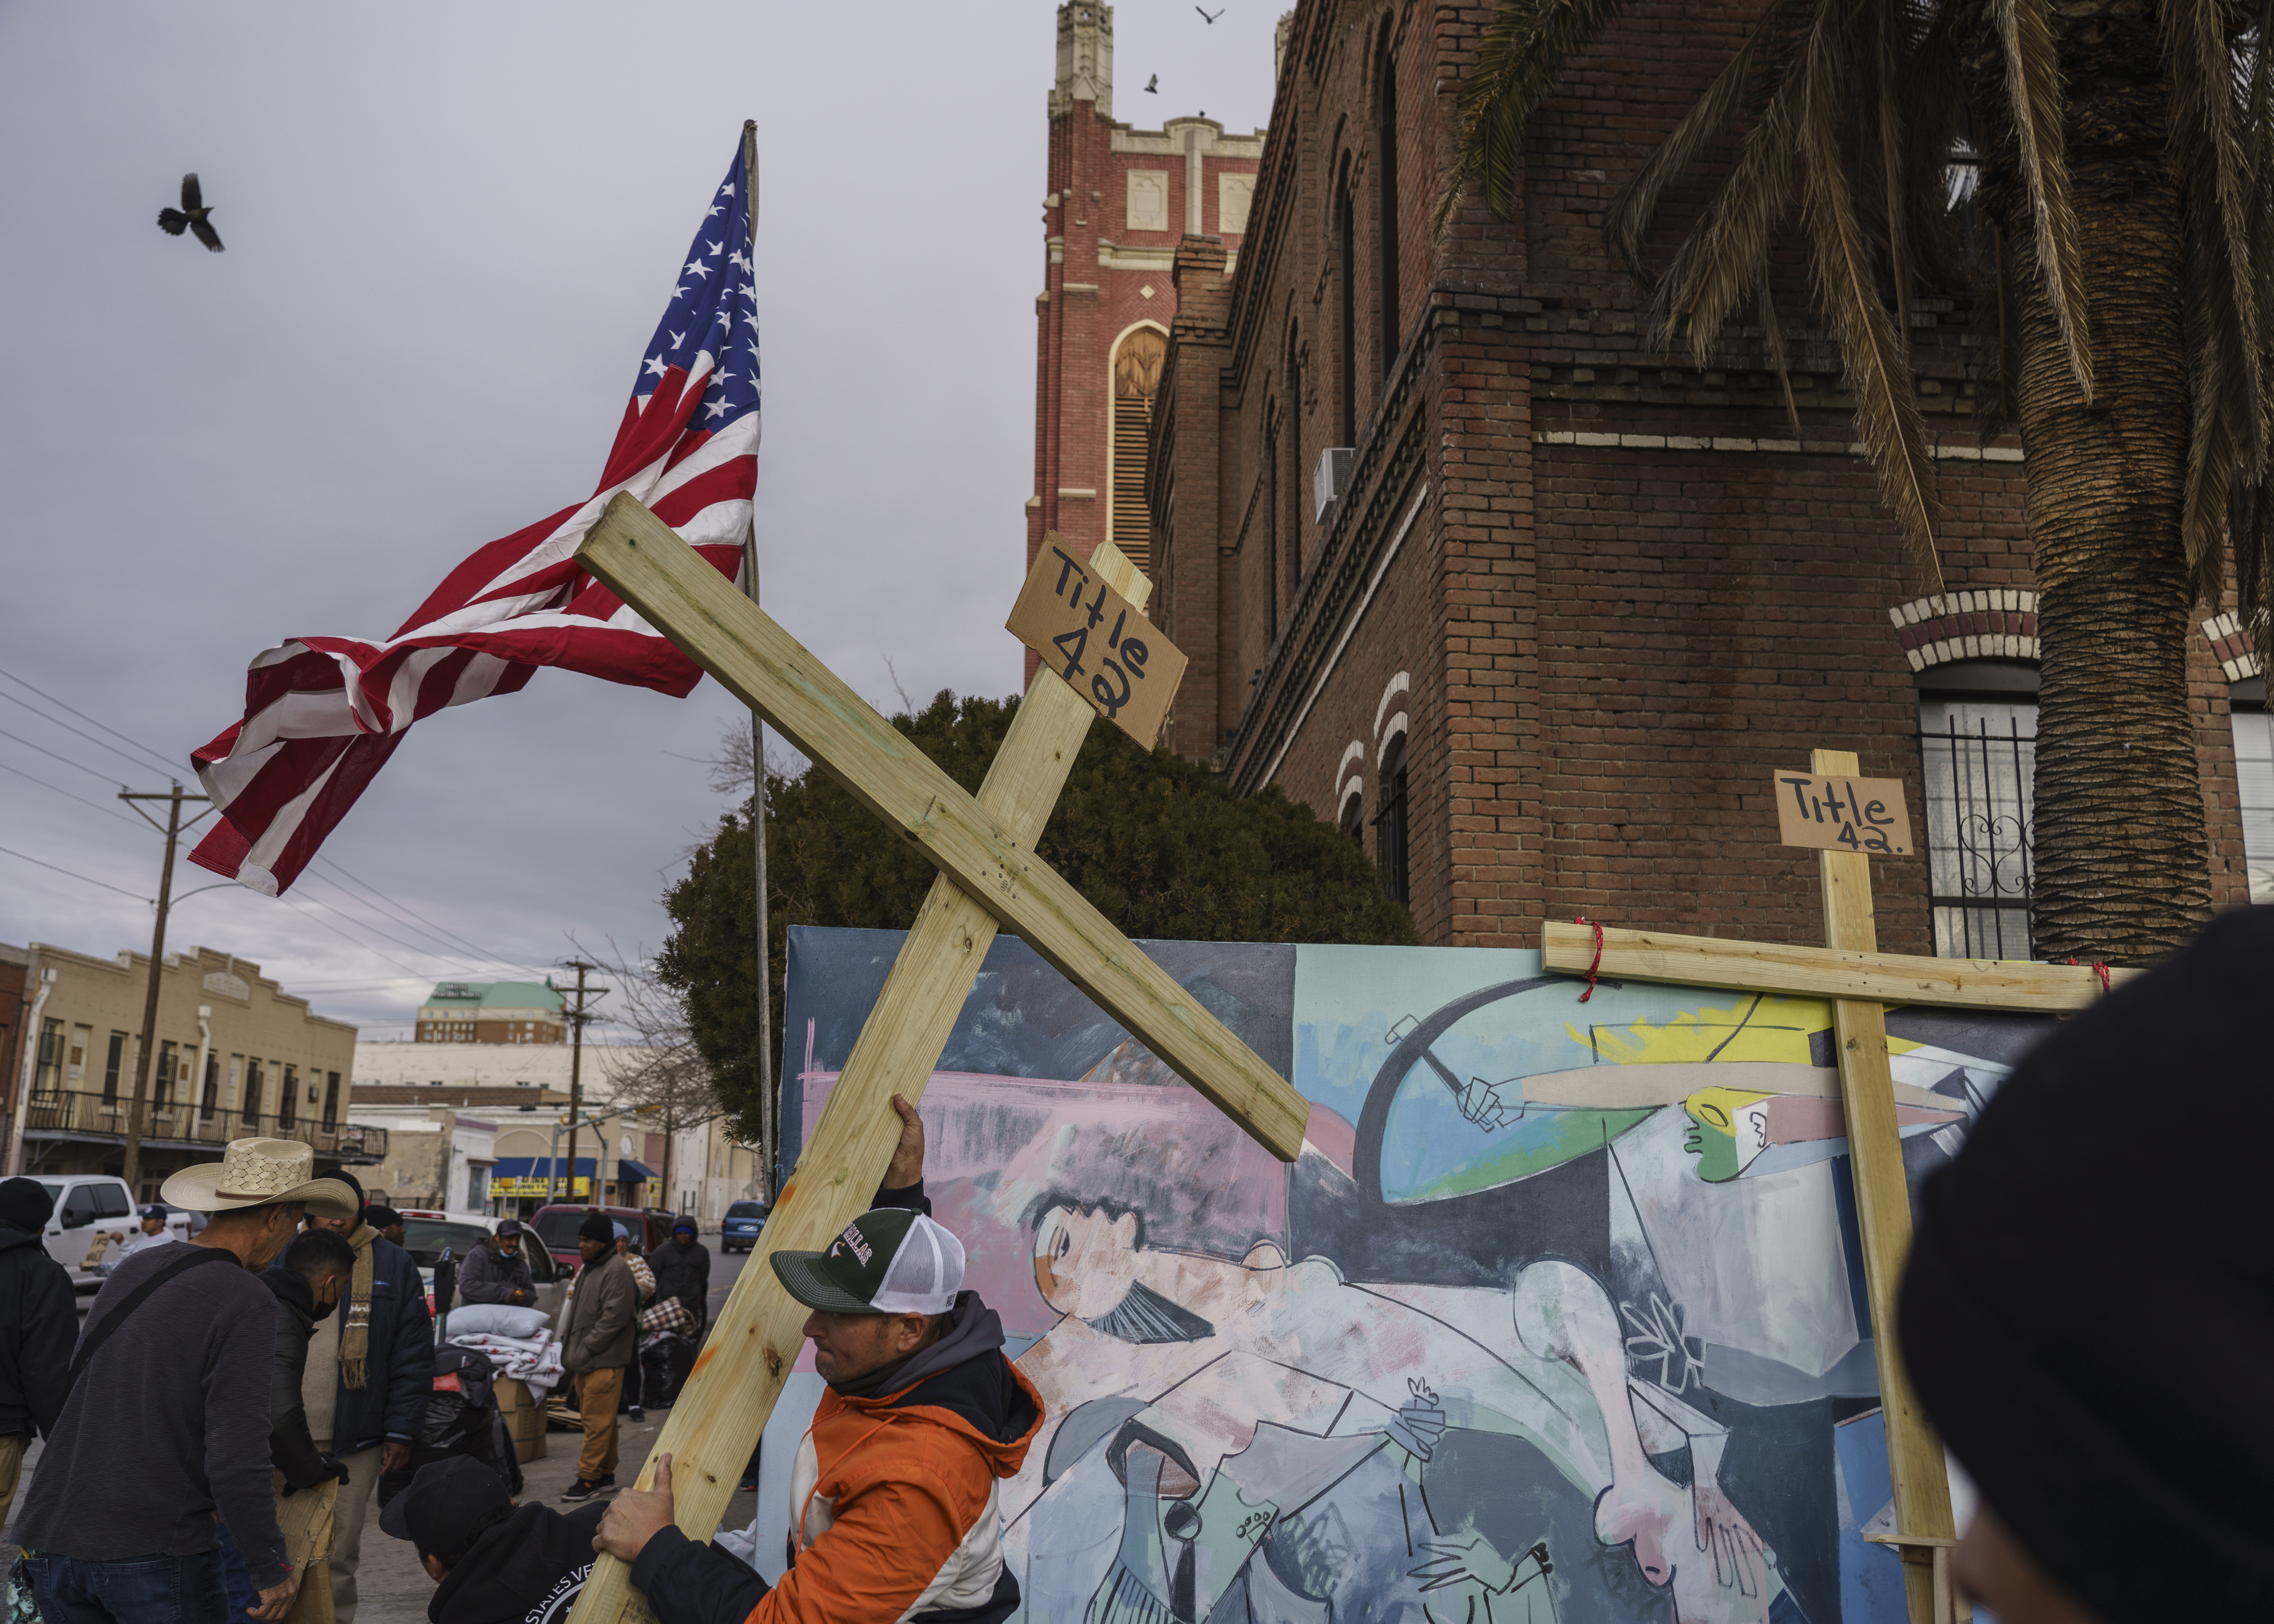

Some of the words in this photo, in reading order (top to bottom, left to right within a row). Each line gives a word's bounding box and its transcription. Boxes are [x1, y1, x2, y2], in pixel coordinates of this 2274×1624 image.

[1053, 546, 1148, 679] Title
[1052, 627, 1131, 719] 42
[1780, 778, 1895, 826] Title
